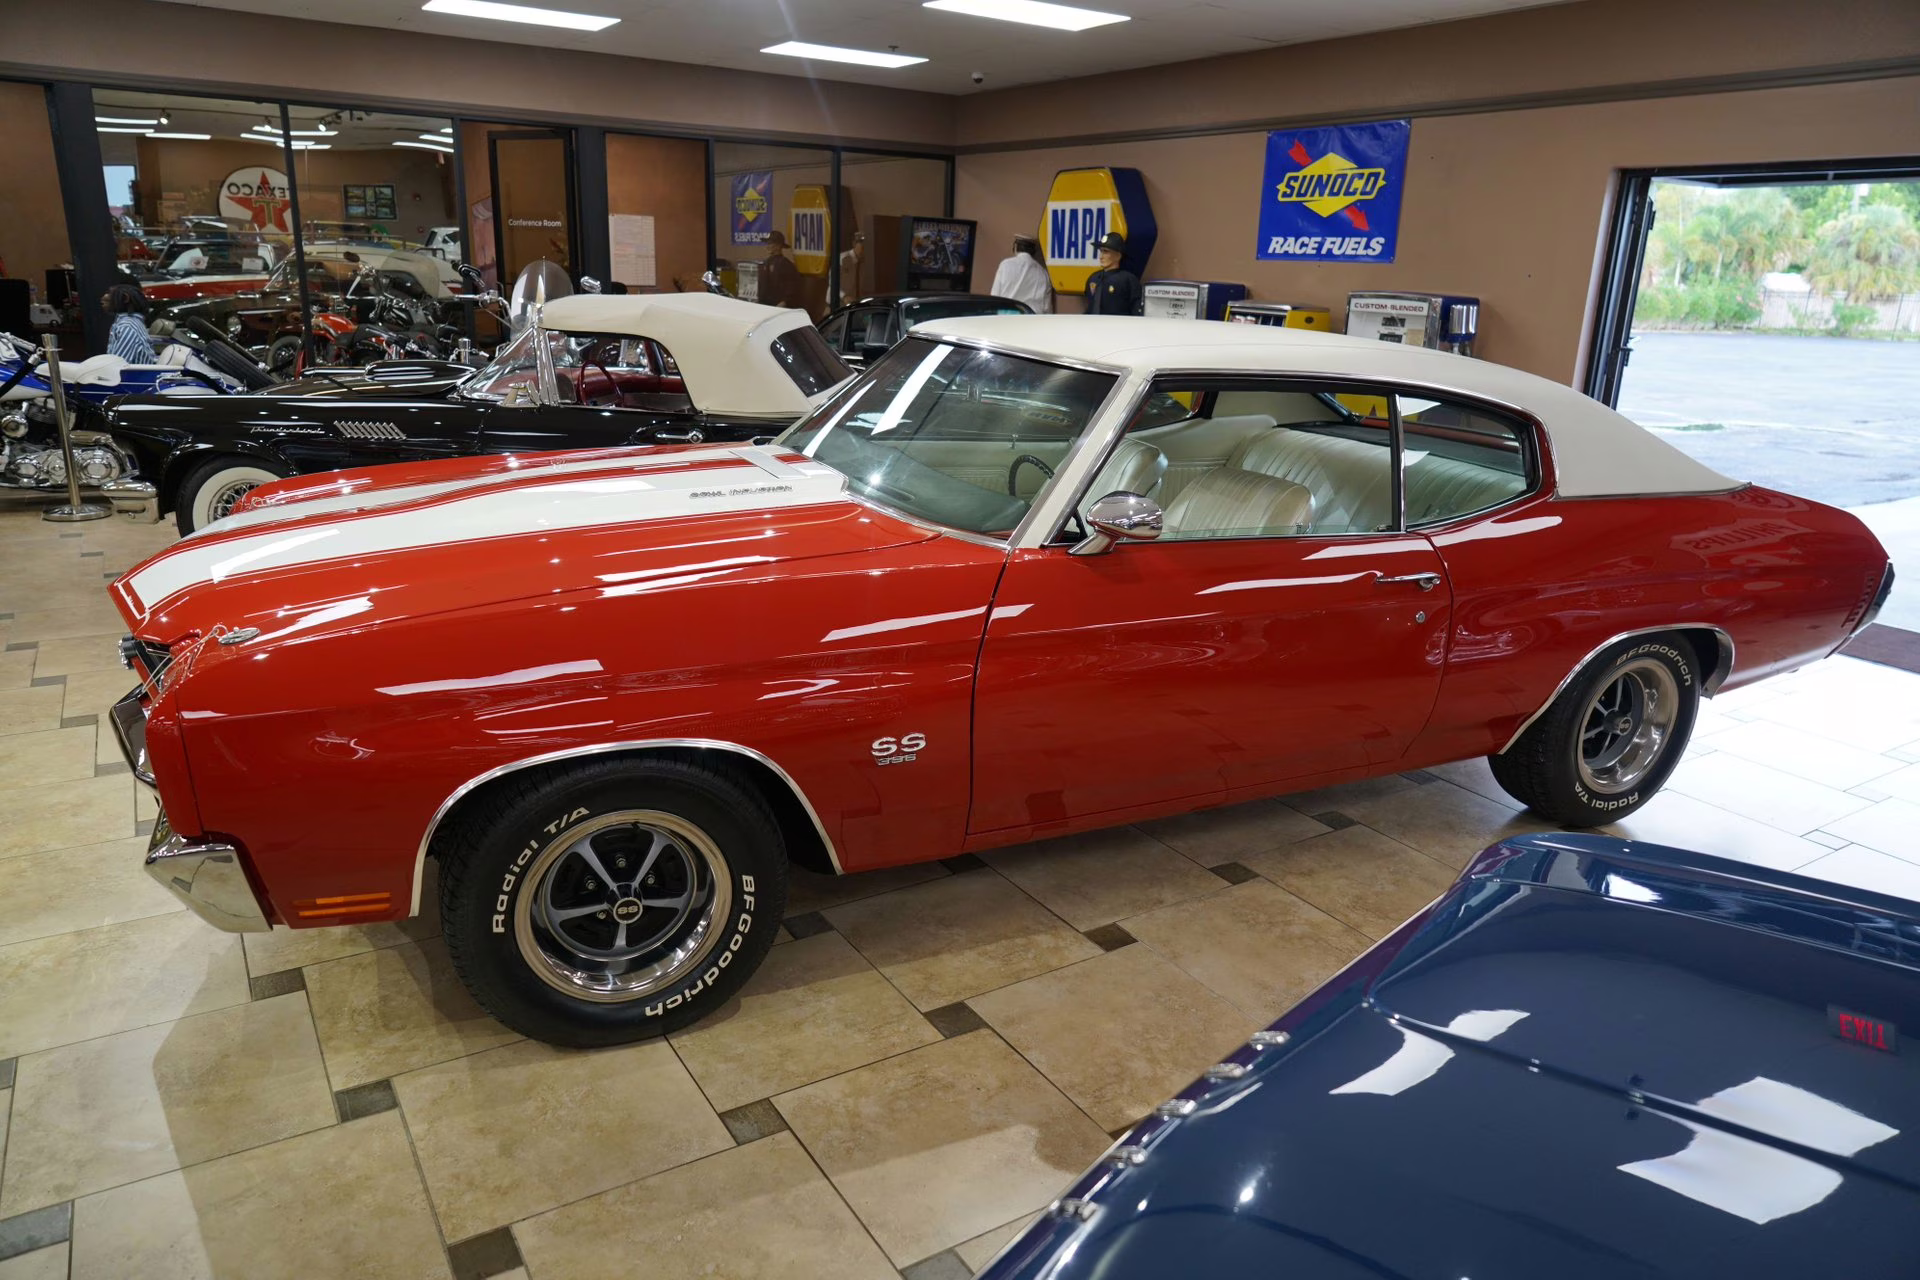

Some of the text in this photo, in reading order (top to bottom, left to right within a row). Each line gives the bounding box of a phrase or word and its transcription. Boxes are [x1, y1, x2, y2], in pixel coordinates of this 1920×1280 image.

[1280, 172, 1382, 198] SUNOCO
[508, 219, 562, 227] Conference Room
[1050, 207, 1106, 259] NAPA
[1267, 236, 1386, 256] RACE FUELS
[1616, 644, 1692, 687] BFGoodrich
[872, 733, 927, 756] SS
[1591, 791, 1639, 811] Radial
[492, 806, 591, 933] Radial T/A
[644, 874, 755, 1017] BFGoodrich
